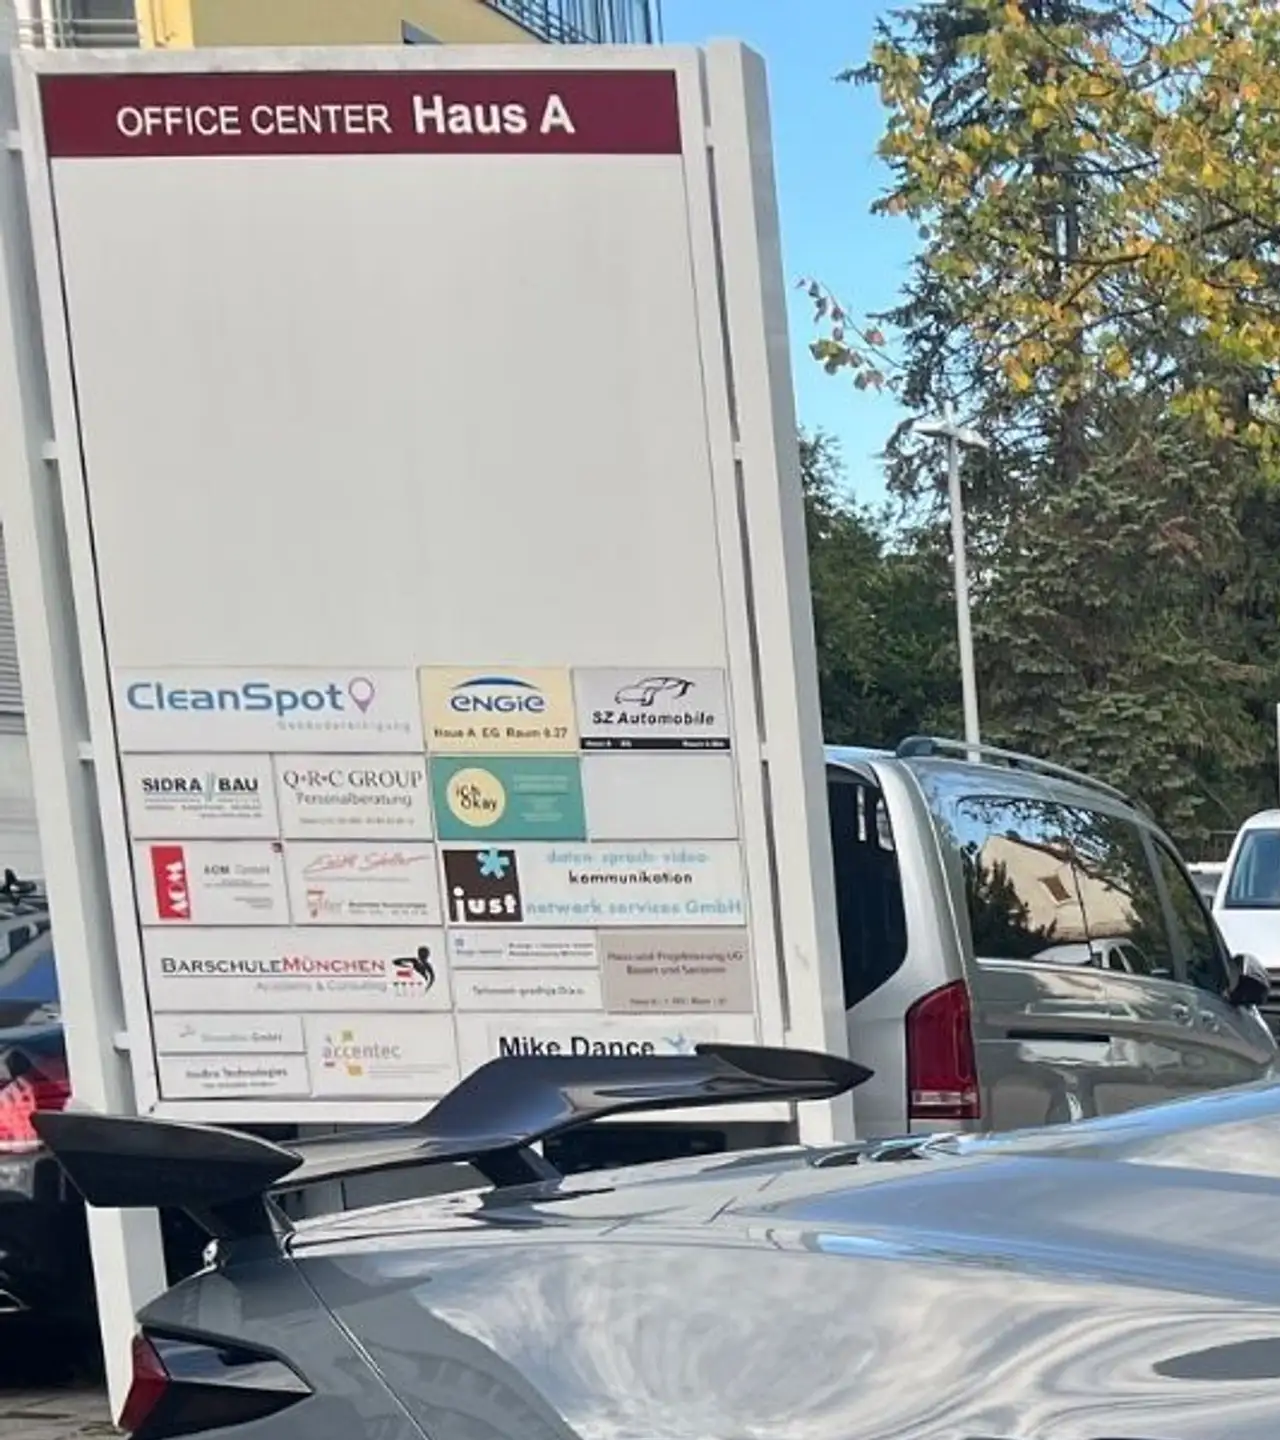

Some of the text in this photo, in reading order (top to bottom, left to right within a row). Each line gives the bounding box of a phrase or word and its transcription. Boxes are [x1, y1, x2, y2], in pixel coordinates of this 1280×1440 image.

[117, 94, 576, 137] OFFICE CENTER Haus A
[126, 681, 345, 716] CleanSpot
[592, 710, 715, 726] SZ Automobile
[218, 777, 259, 792] BAU
[347, 769, 422, 788] GROUP
[568, 869, 694, 885] kommunikation
[453, 886, 518, 923] just
[526, 898, 742, 915] network services GmbH
[498, 1036, 655, 1057] Mike Dance
